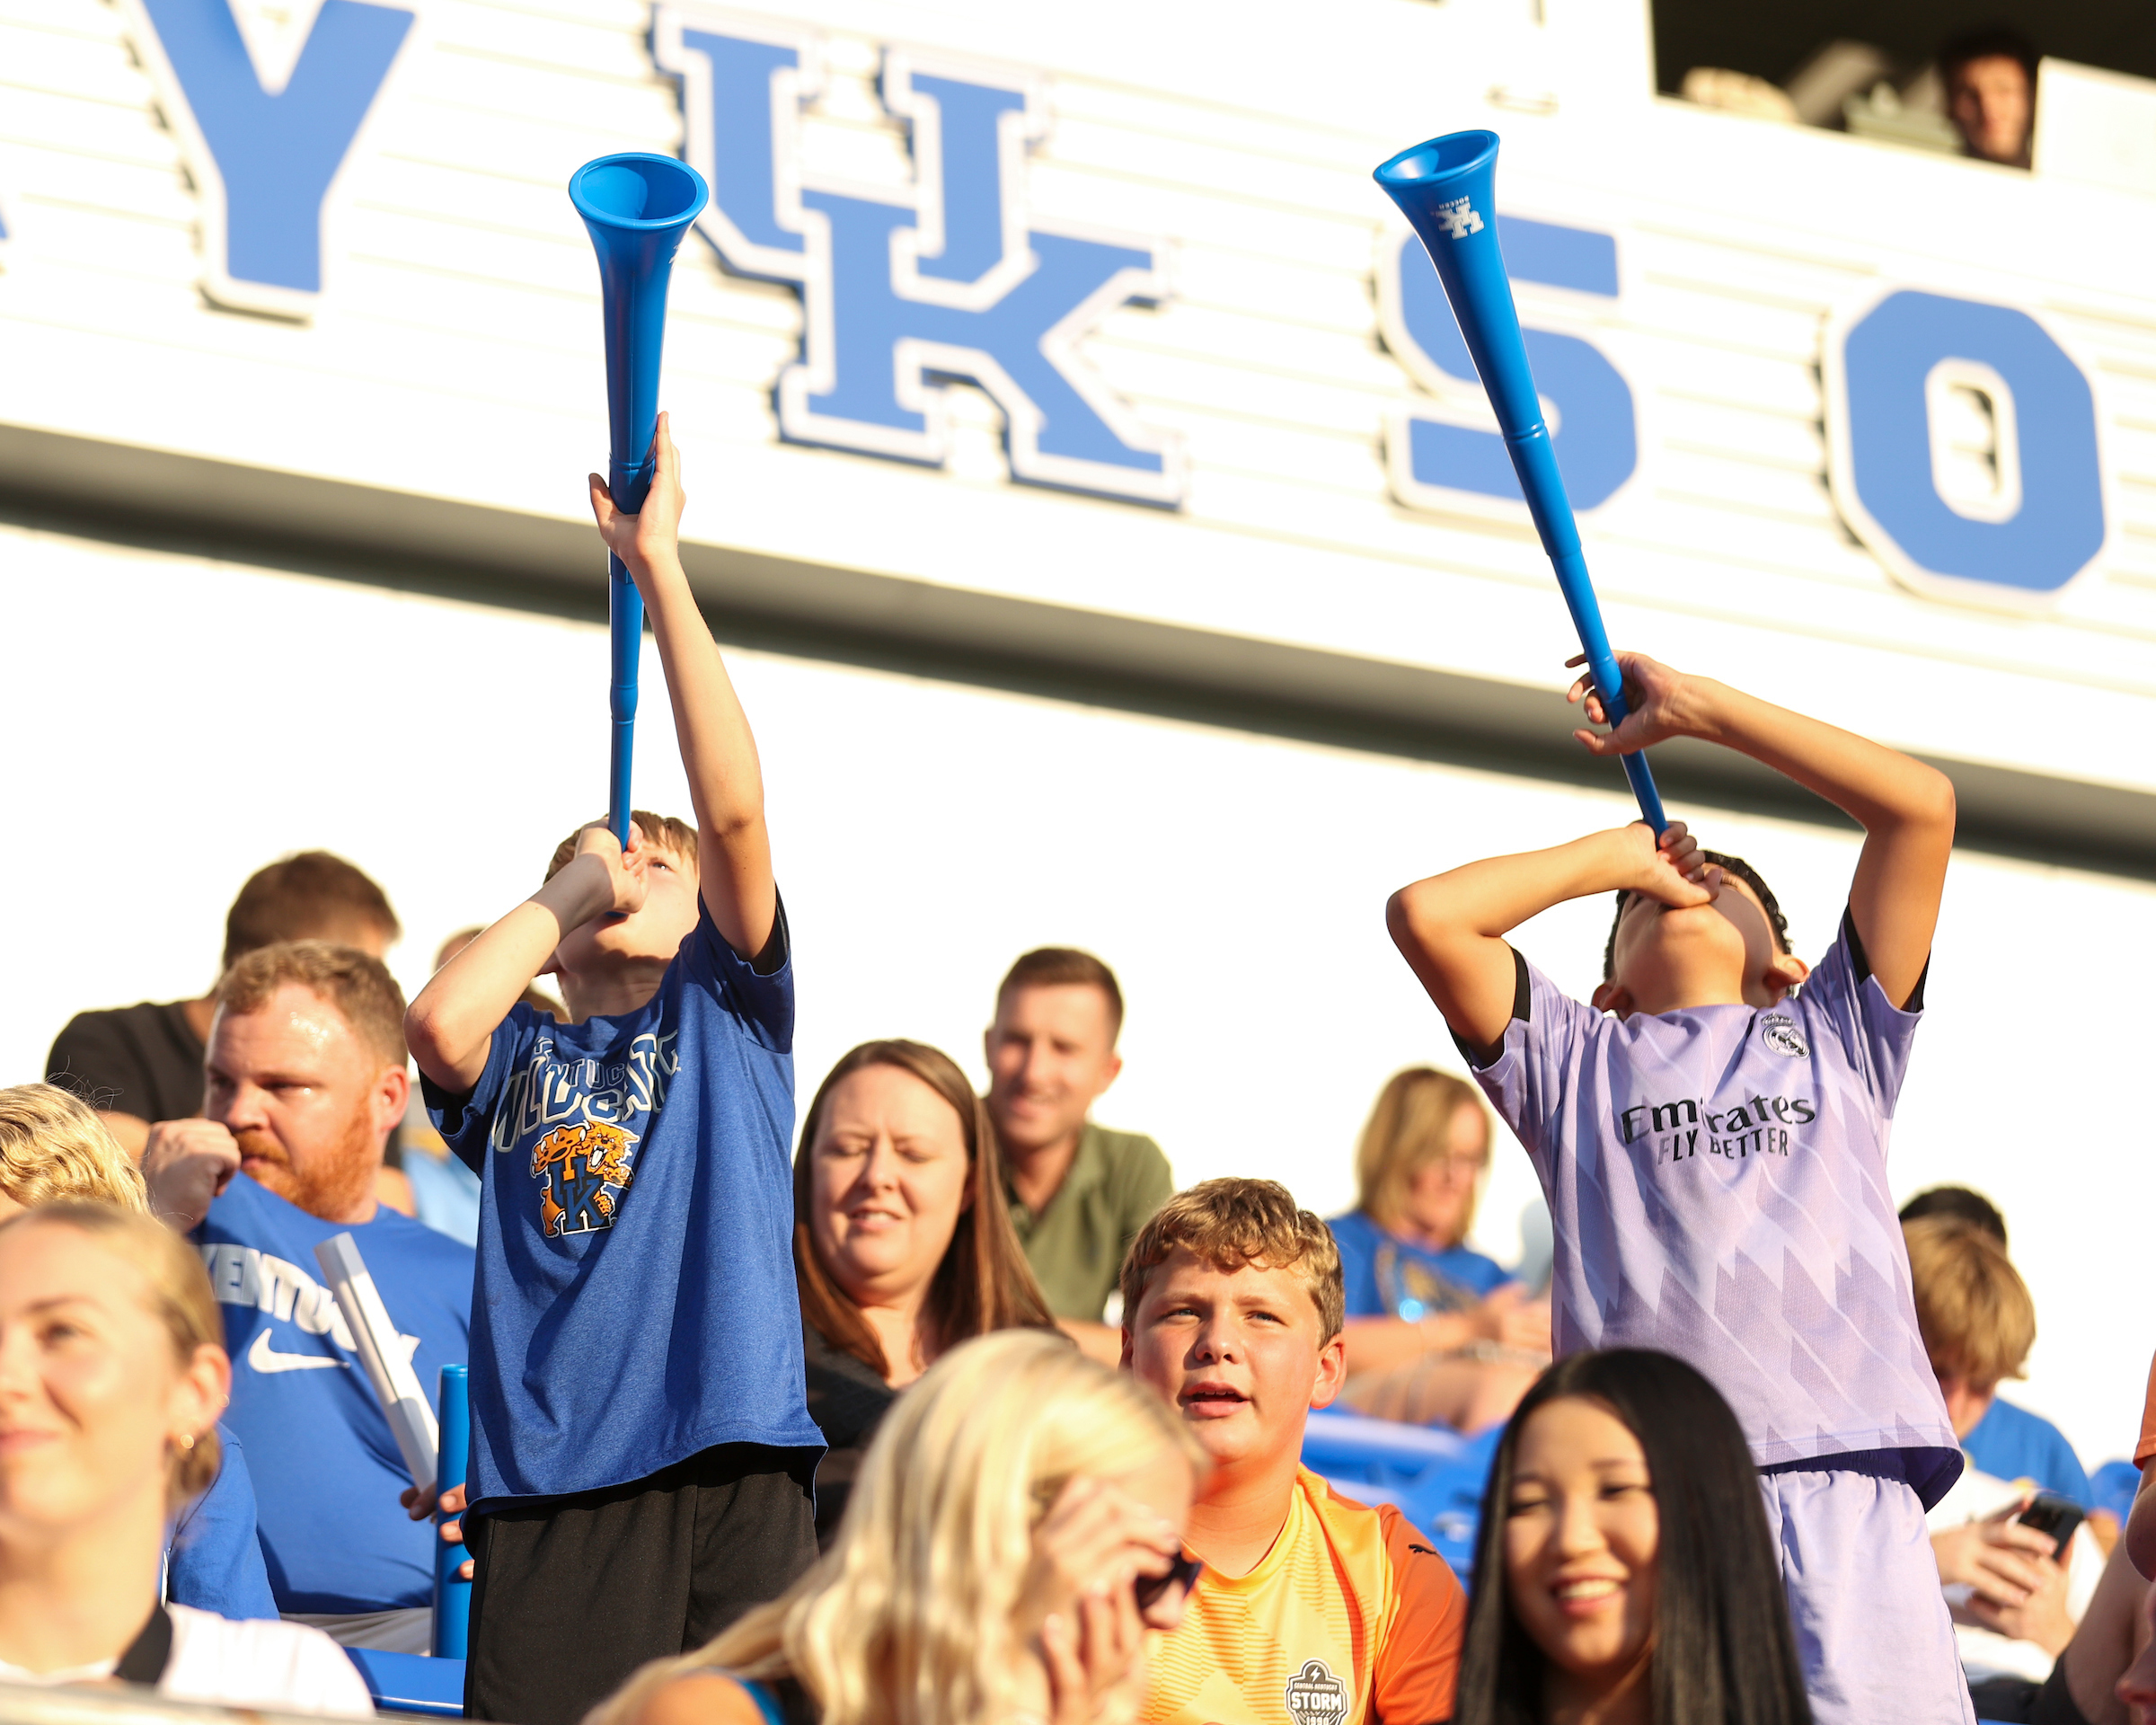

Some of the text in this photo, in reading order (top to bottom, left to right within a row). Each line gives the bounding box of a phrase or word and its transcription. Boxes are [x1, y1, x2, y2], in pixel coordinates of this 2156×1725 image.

[663, 9, 1173, 499] UK
[1657, 1128, 1789, 1165] FLY BETTER
[1291, 1691, 1343, 1712] STORM
